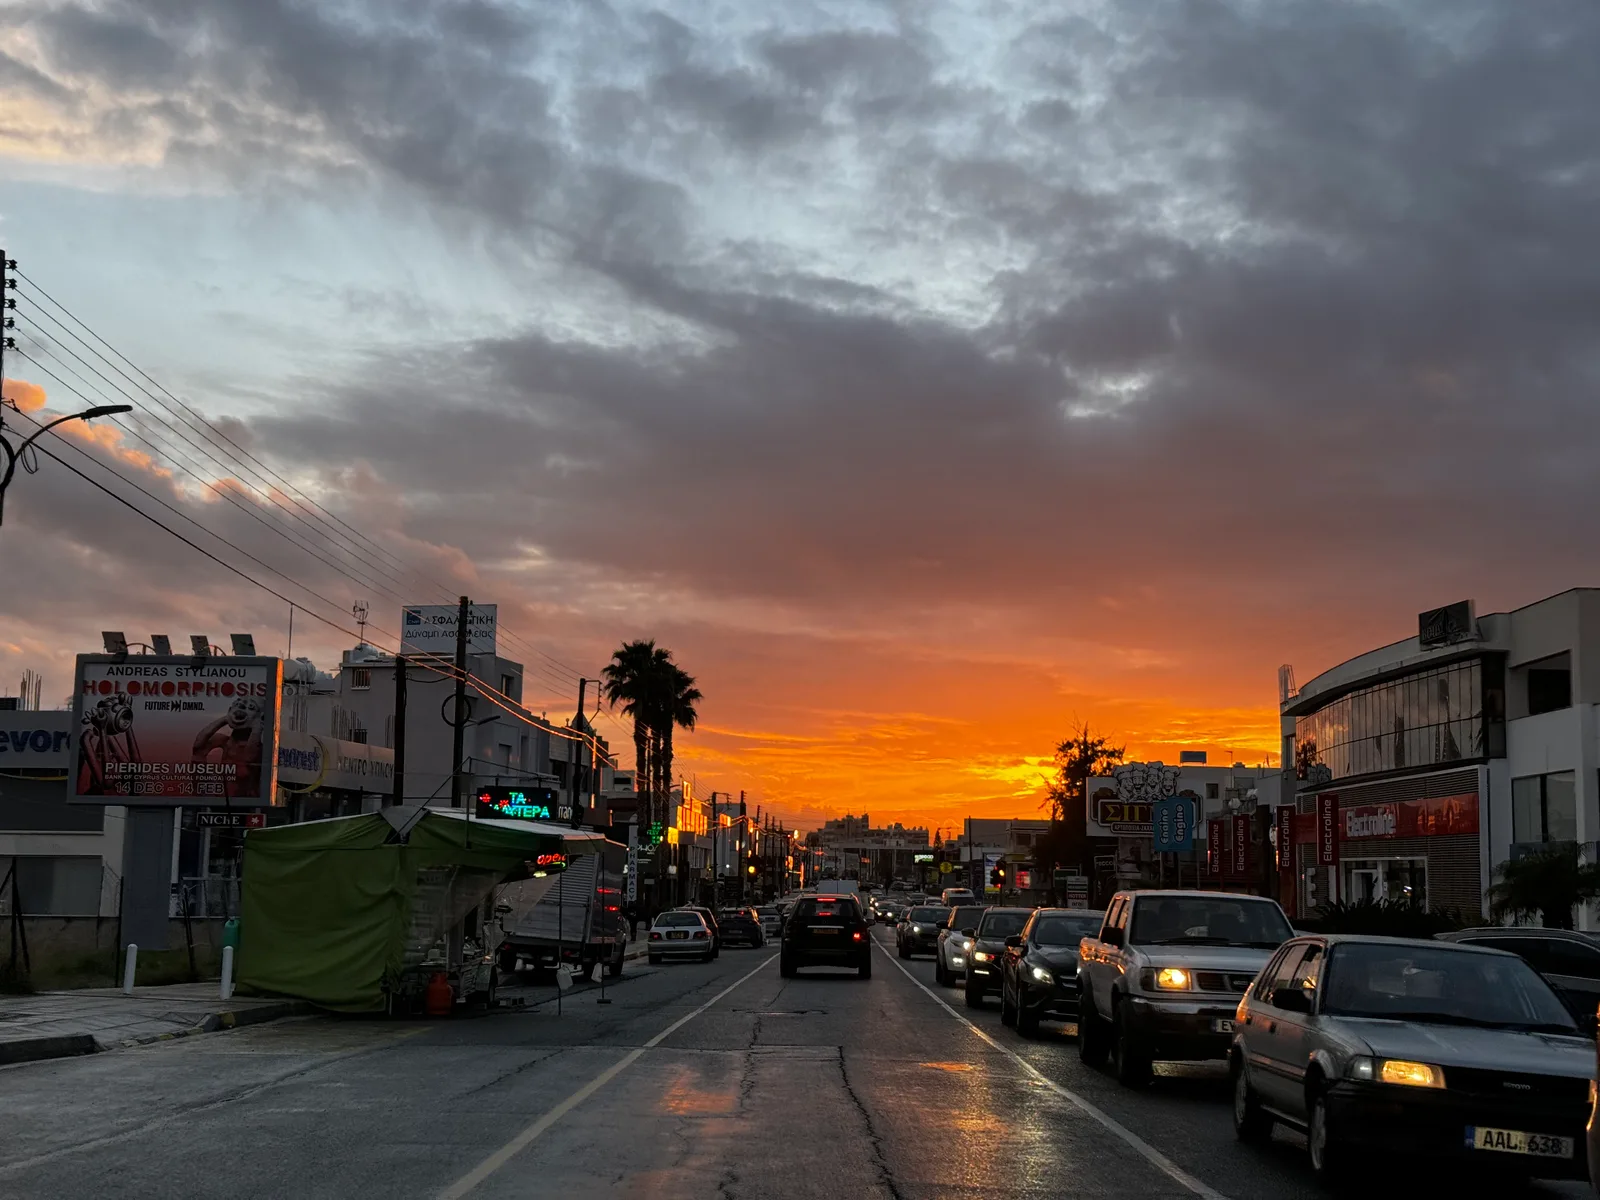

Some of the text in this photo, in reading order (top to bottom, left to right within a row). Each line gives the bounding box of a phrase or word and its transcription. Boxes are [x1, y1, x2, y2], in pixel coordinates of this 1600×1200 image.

[424, 616, 493, 625] ΑΣΦΑΛΣΤΙΚΗ
[107, 667, 246, 678] ANDREAS STYLIANOU
[83, 679, 267, 697] HOLOMORPHOSIS
[144, 701, 170, 711] FUTURE
[105, 762, 237, 775] PIERIDES MUSEUM
[115, 782, 131, 794] 14
[134, 782, 164, 795] DEC
[178, 782, 195, 795] 14
[197, 783, 225, 795] FEB
[200, 815, 240, 825] NICHE
[1105, 804, 1153, 822] ΣΙΓ
[1281, 809, 1290, 868] Electroline
[1323, 799, 1332, 862] Electroline
[1211, 823, 1220, 873] Electroline
[1236, 819, 1245, 871] Electroline
[1483, 1130, 1561, 1154] AAL 638
